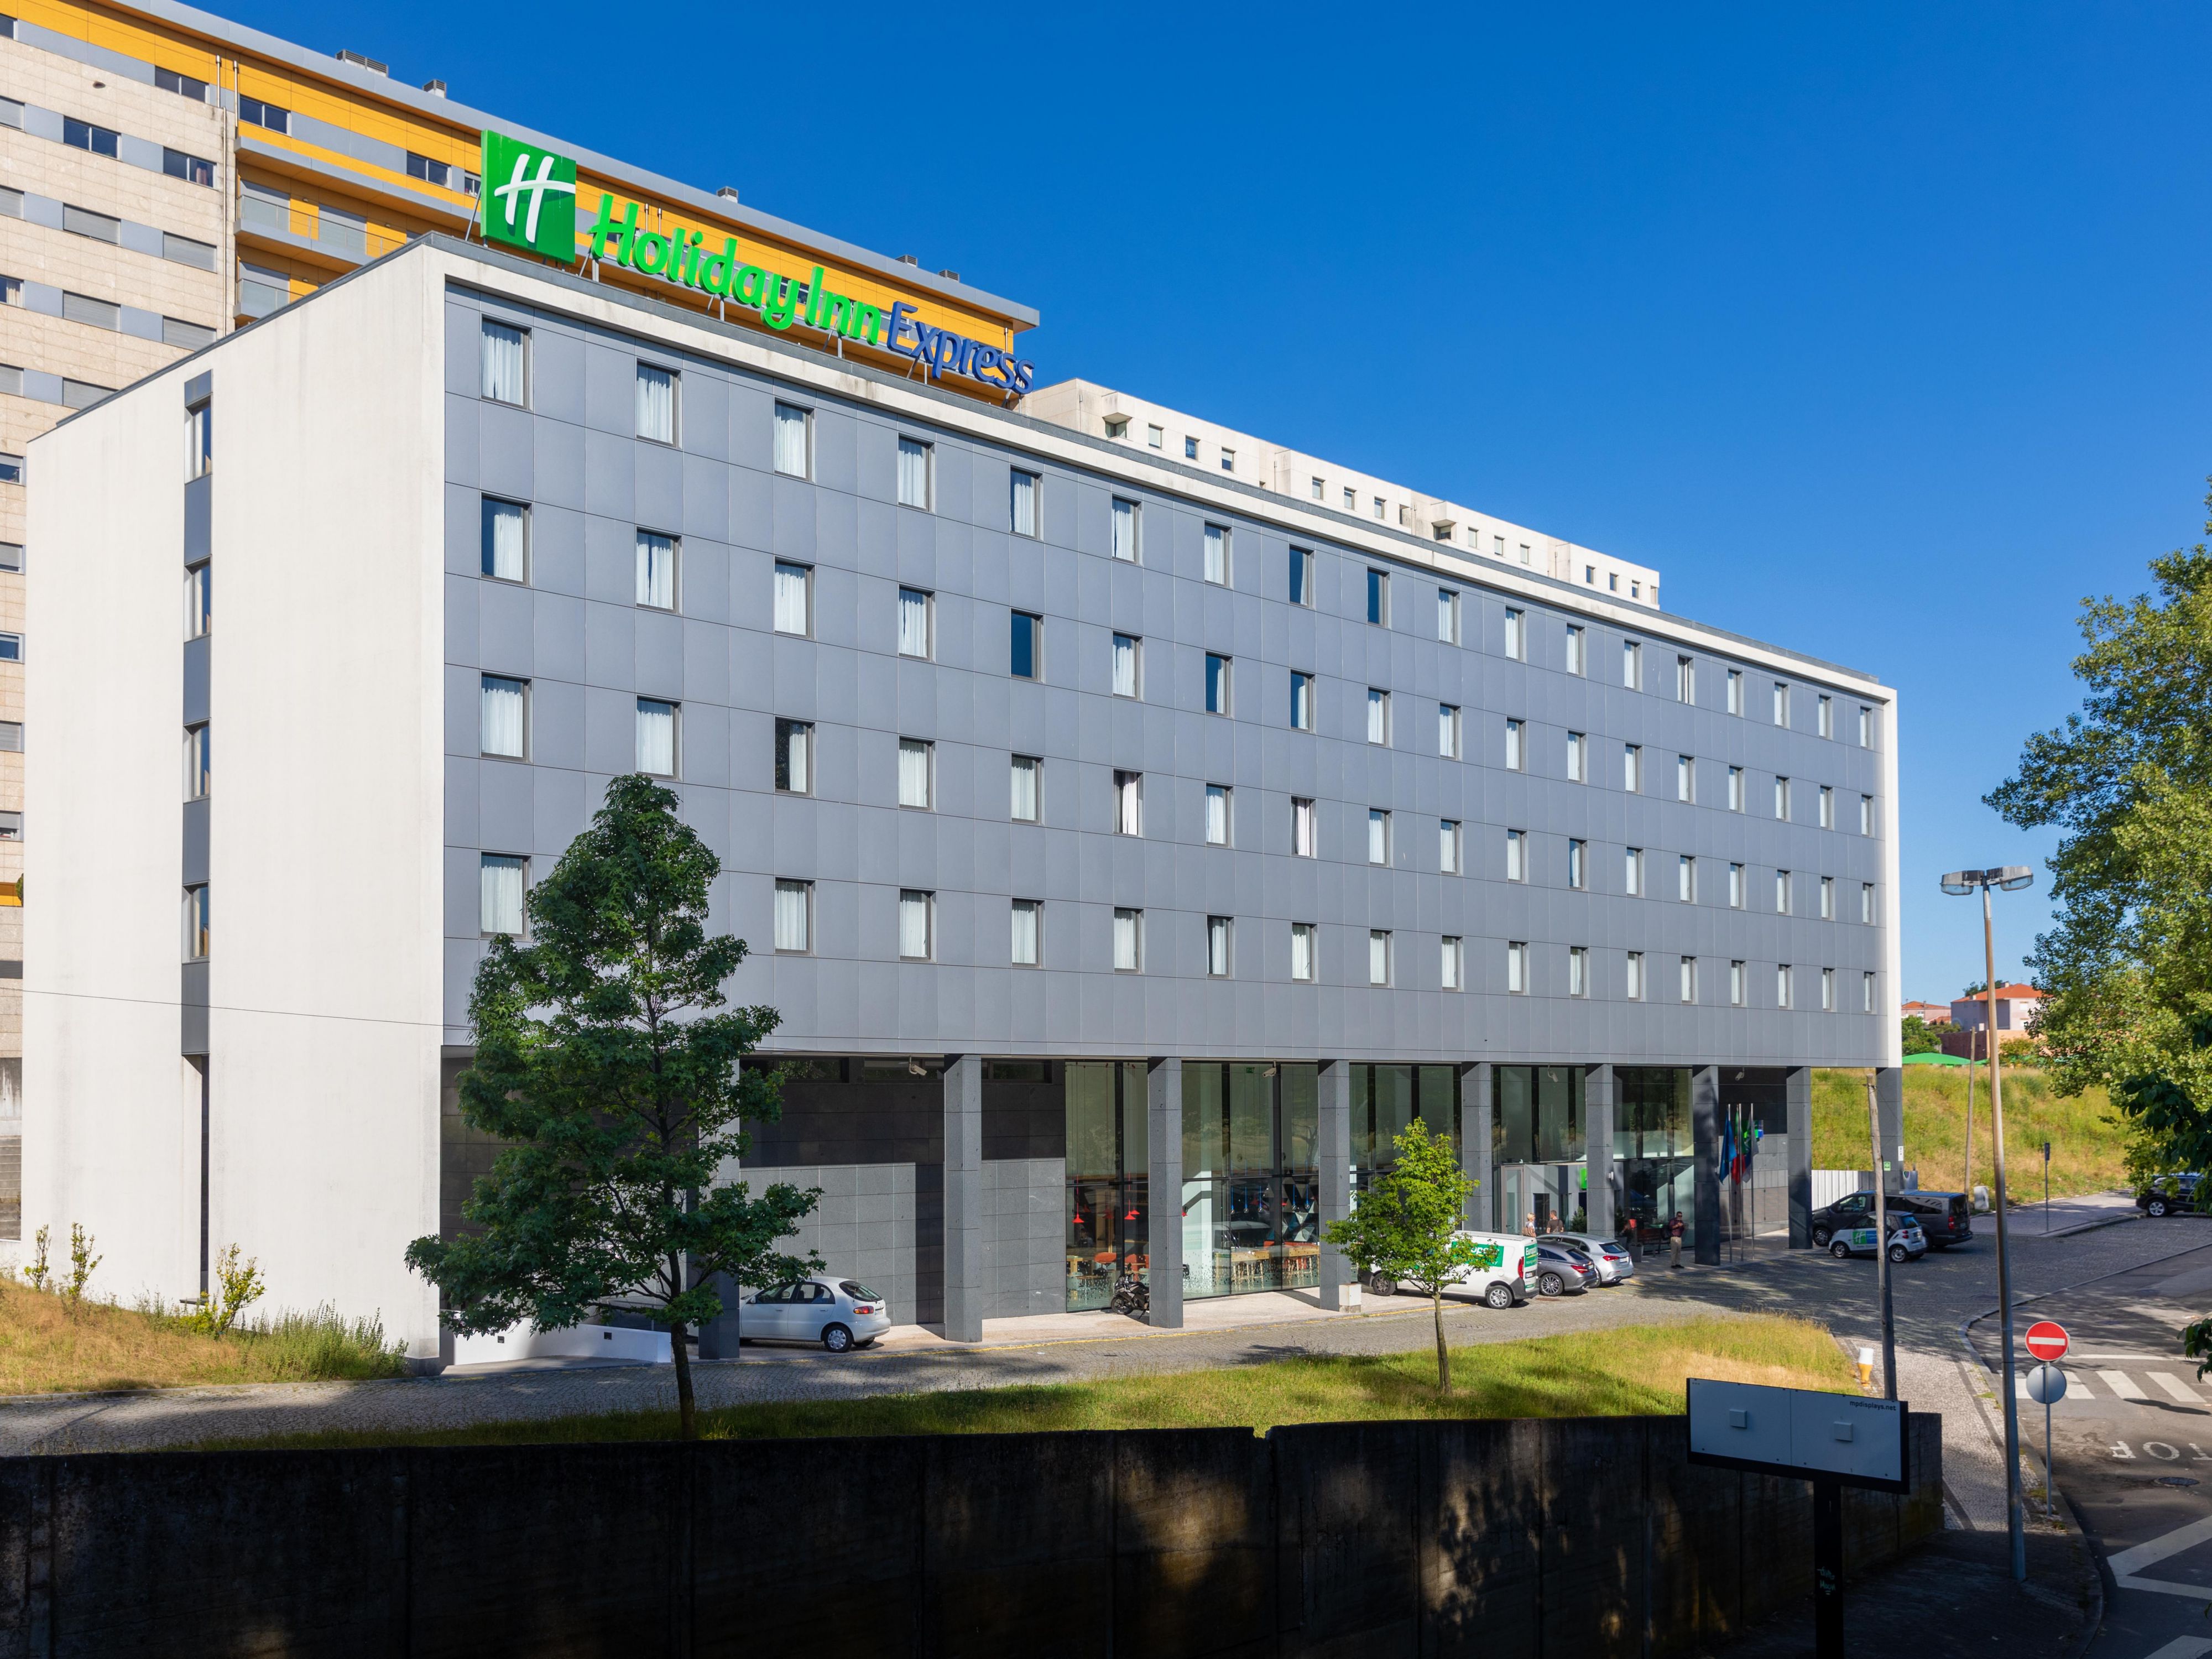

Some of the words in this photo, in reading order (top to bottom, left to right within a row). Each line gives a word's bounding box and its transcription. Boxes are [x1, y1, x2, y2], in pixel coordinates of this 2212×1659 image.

[587, 194, 801, 330] Holiday
[805, 266, 881, 346] Inn
[886, 301, 1035, 394] Express
[1849, 1401, 1896, 1411] mpdisplays.net
